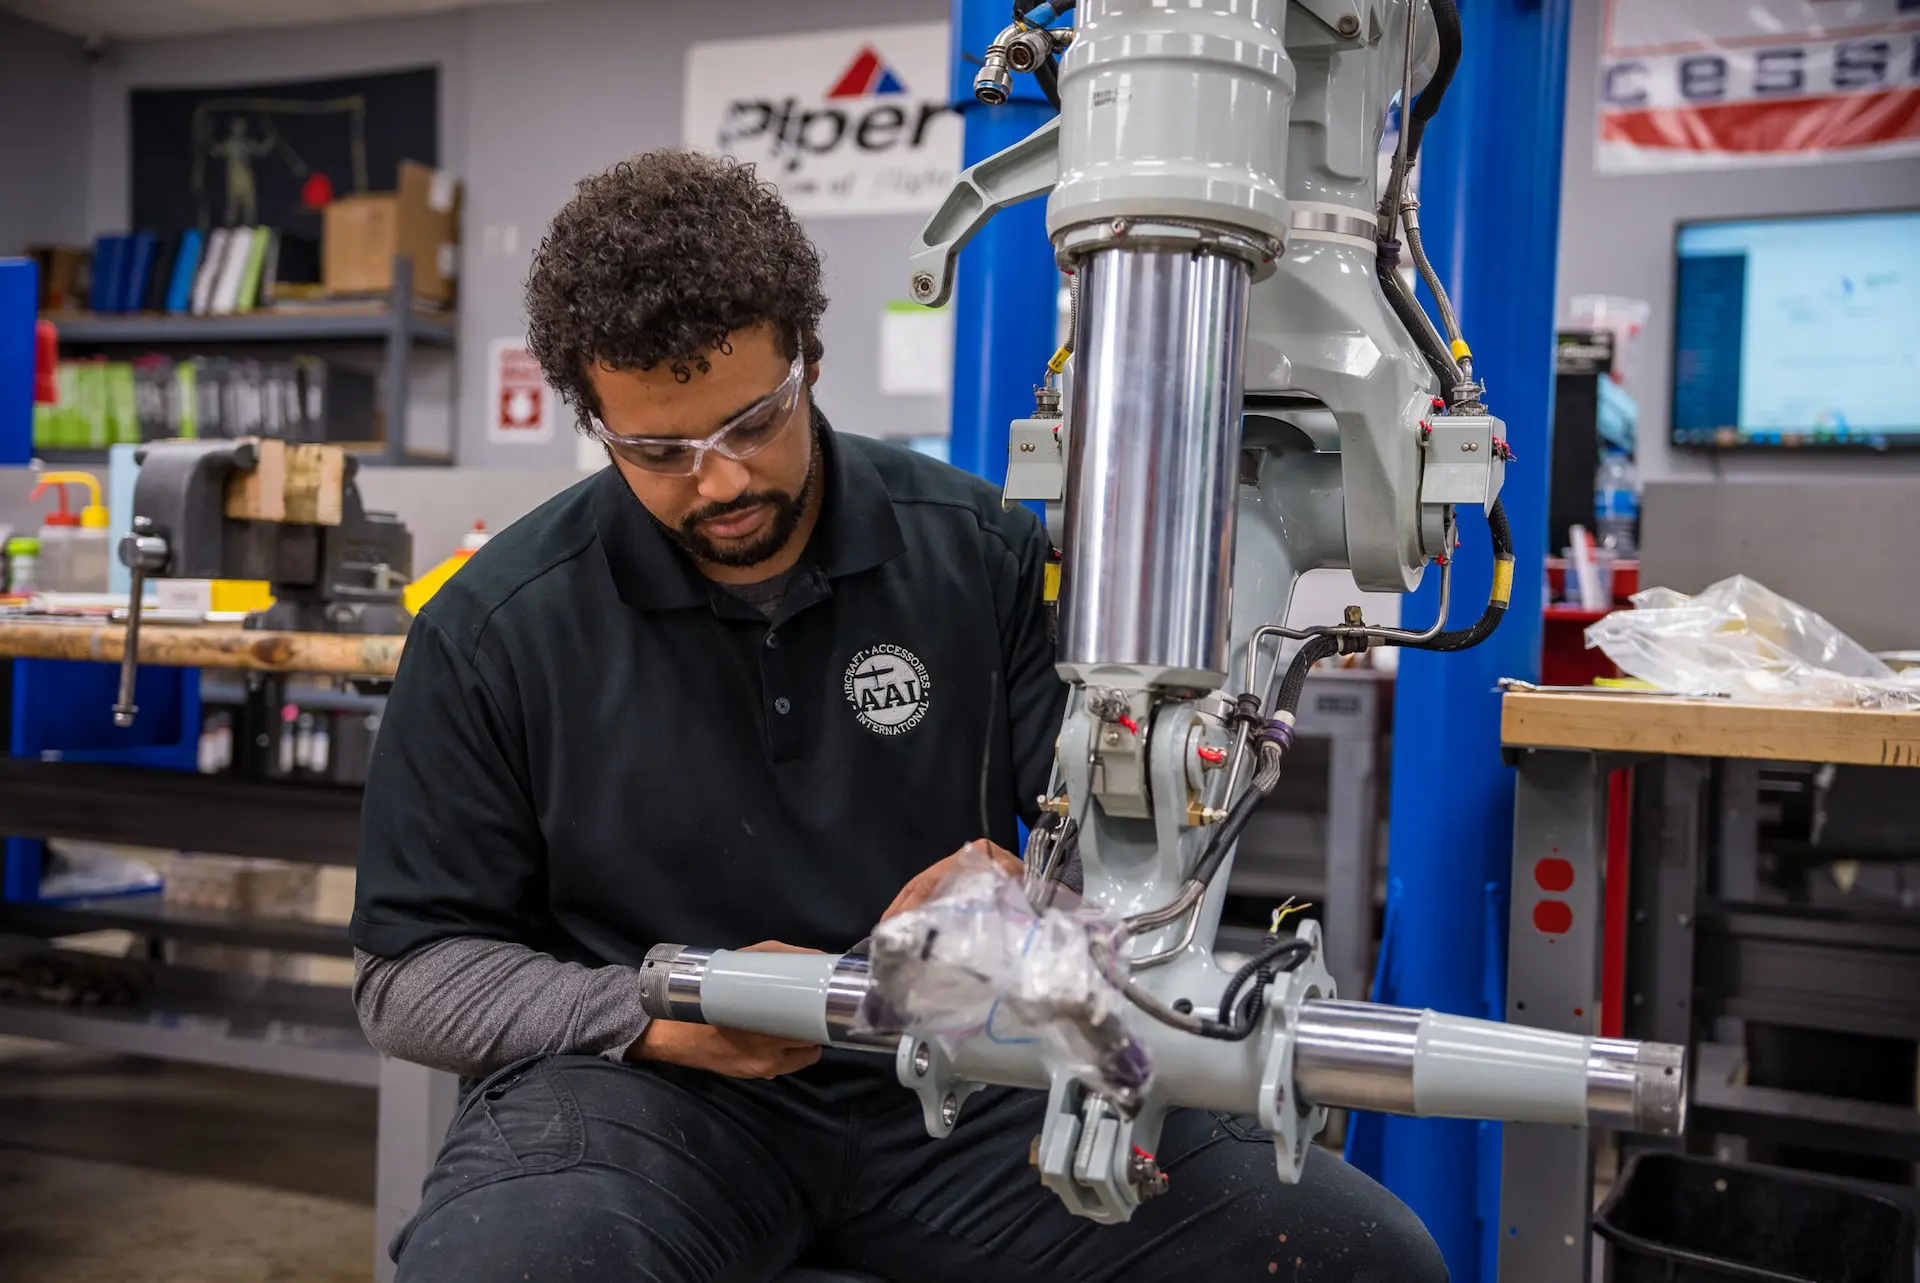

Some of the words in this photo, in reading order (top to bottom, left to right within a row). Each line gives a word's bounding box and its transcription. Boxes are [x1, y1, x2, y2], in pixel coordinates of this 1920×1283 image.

[844, 650, 865, 702] AIRCRAFT
[871, 644, 931, 689] ACCESSORIES
[856, 700, 930, 736] INTERNATIONAL
